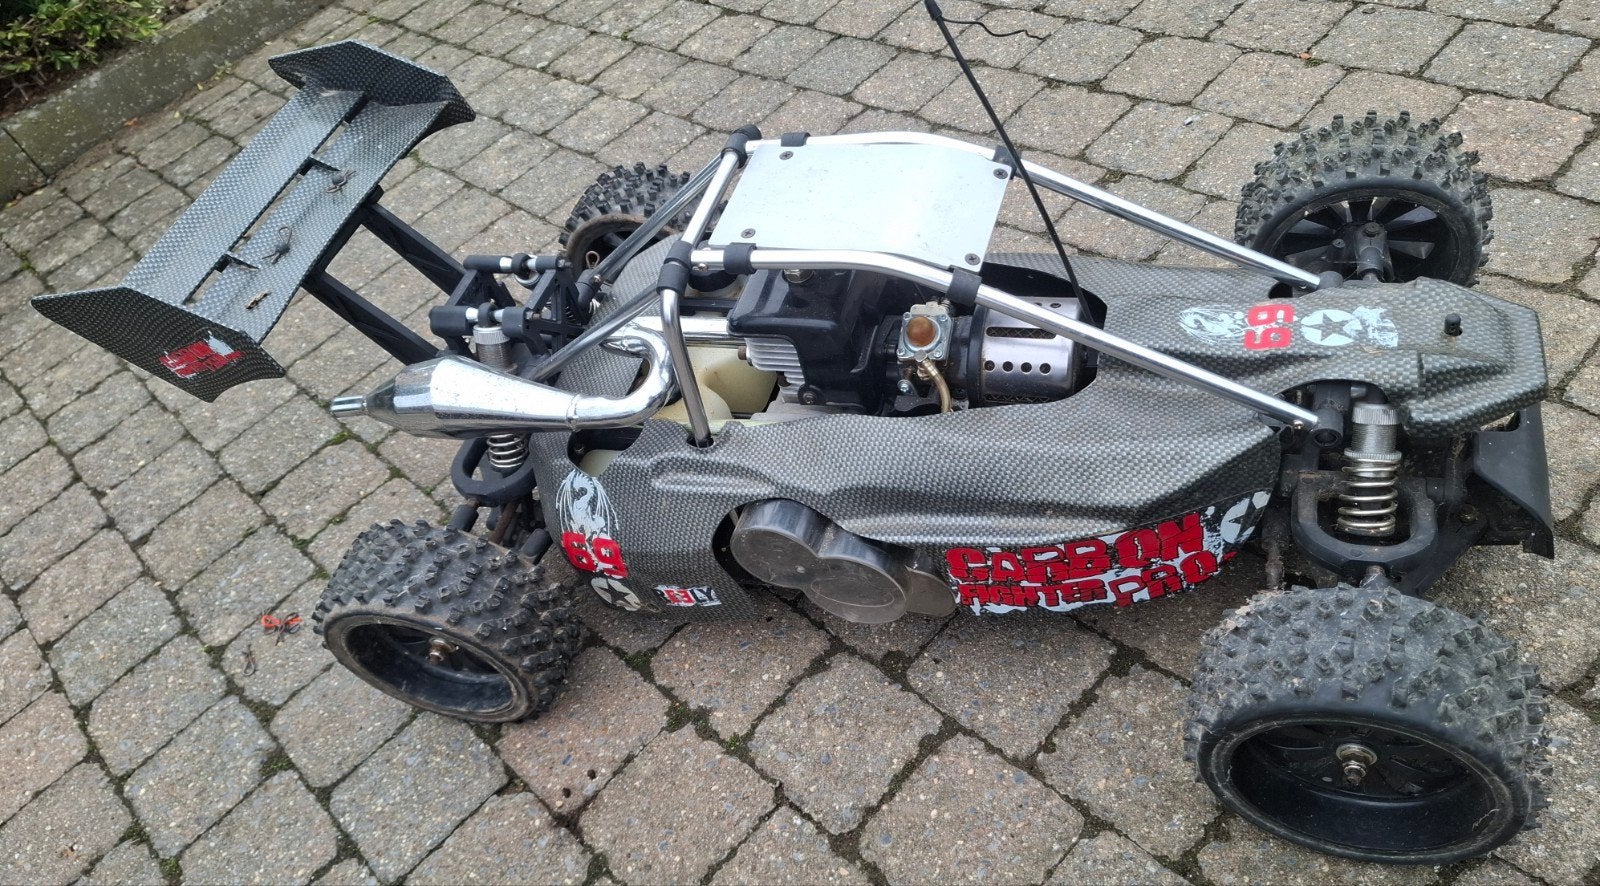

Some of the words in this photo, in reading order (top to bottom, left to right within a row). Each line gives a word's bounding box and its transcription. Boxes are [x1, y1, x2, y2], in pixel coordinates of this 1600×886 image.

[1243, 303, 1296, 350] 69
[561, 531, 629, 578] 69
[946, 512, 1204, 583] CARBON
[958, 579, 1107, 607] FIGHTER
[1108, 551, 1218, 608] PRO
